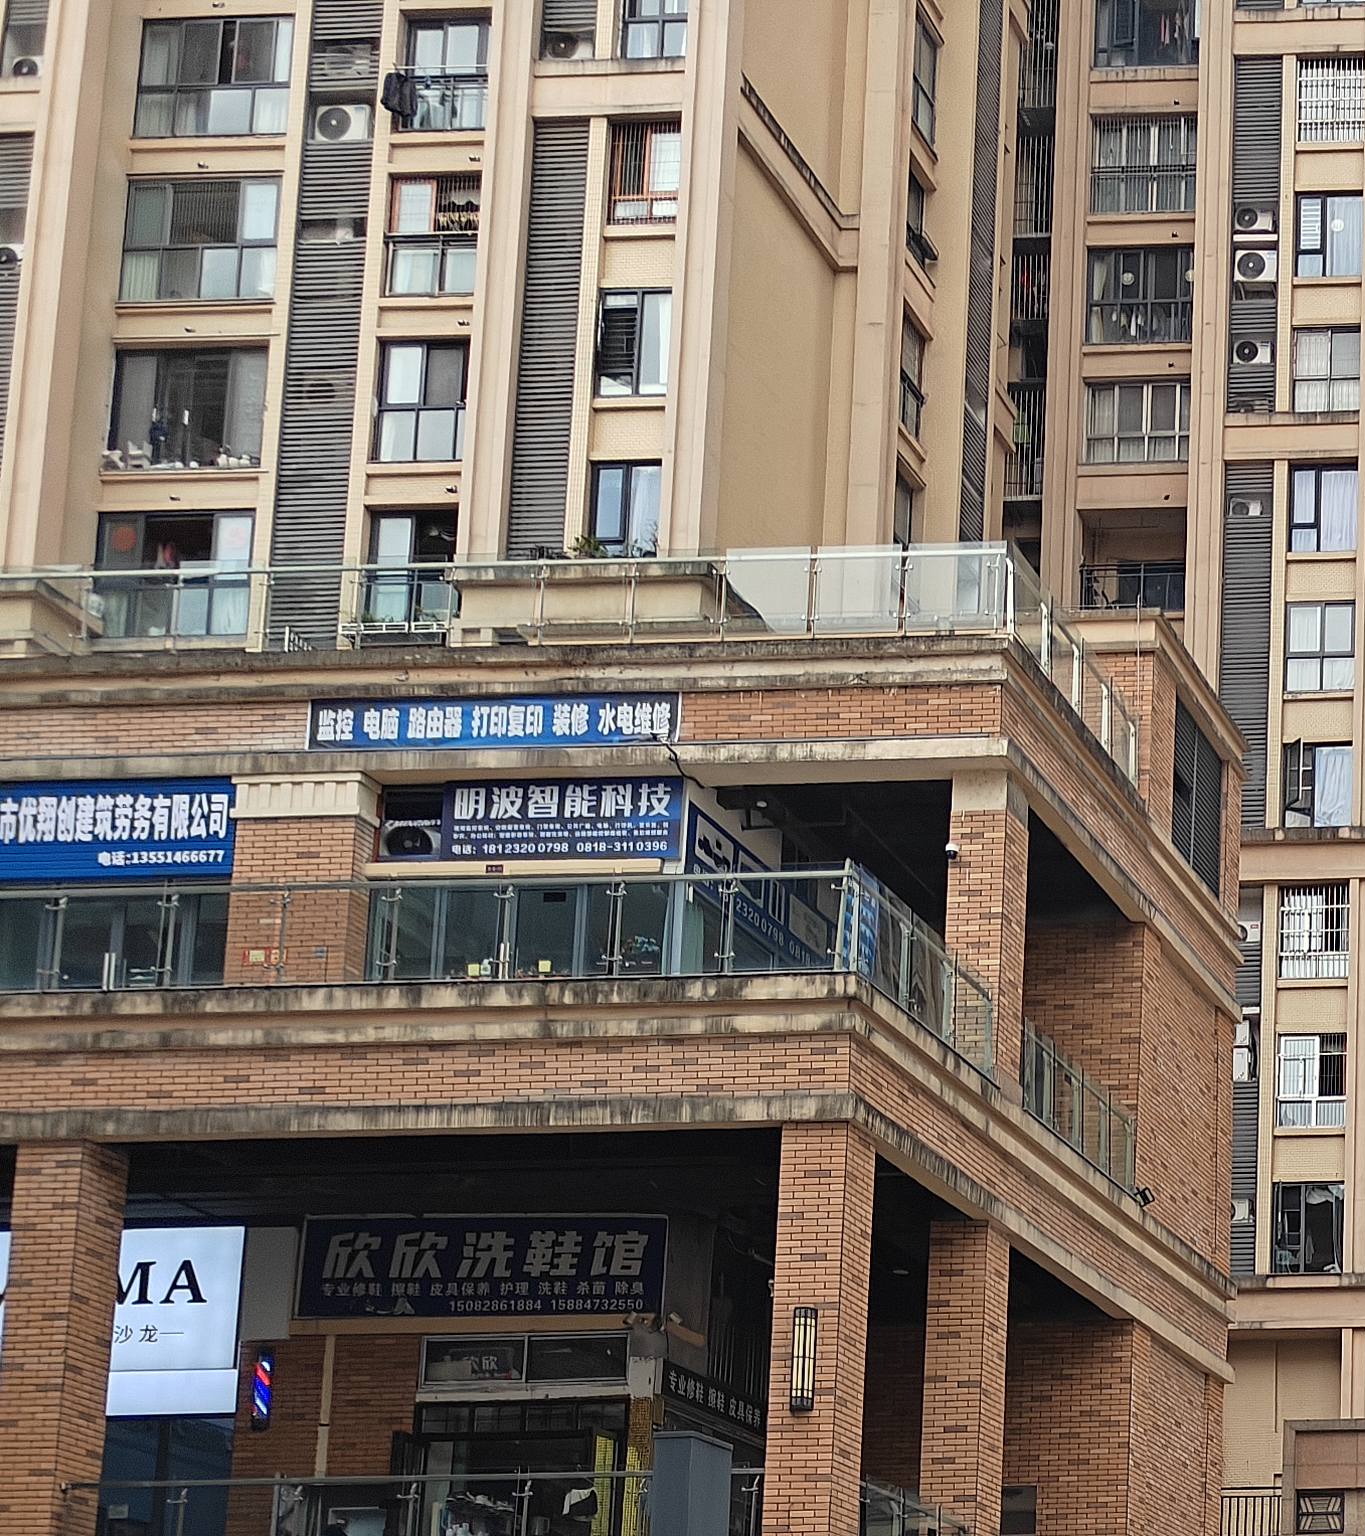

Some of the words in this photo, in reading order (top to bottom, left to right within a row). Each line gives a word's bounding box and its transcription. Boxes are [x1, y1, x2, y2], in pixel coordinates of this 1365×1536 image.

[317, 709, 354, 741] 监控
[363, 707, 400, 740] 电脑
[407, 706, 463, 739] 路由器
[472, 705, 543, 738] 打印复印
[553, 703, 588, 737] 装修
[598, 702, 671, 737] 水电维修
[453, 783, 672, 820] 明波智能科技
[576, 841, 668, 853] 0818-3110396
[322, 1230, 649, 1279] 欣欣洗鞋馆
[321, 1283, 382, 1297] 专业修鞋
[430, 1282, 490, 1297] 皮具保养
[500, 1282, 529, 1296] 护理
[538, 1281, 568, 1296] 洗鞋
[576, 1281, 605, 1296] 杀菌
[614, 1281, 645, 1296] 除臭
[449, 1299, 542, 1312] 15082861884
[550, 1299, 644, 1311] 15884732550
[668, 1370, 704, 1404] 专业修鞋
